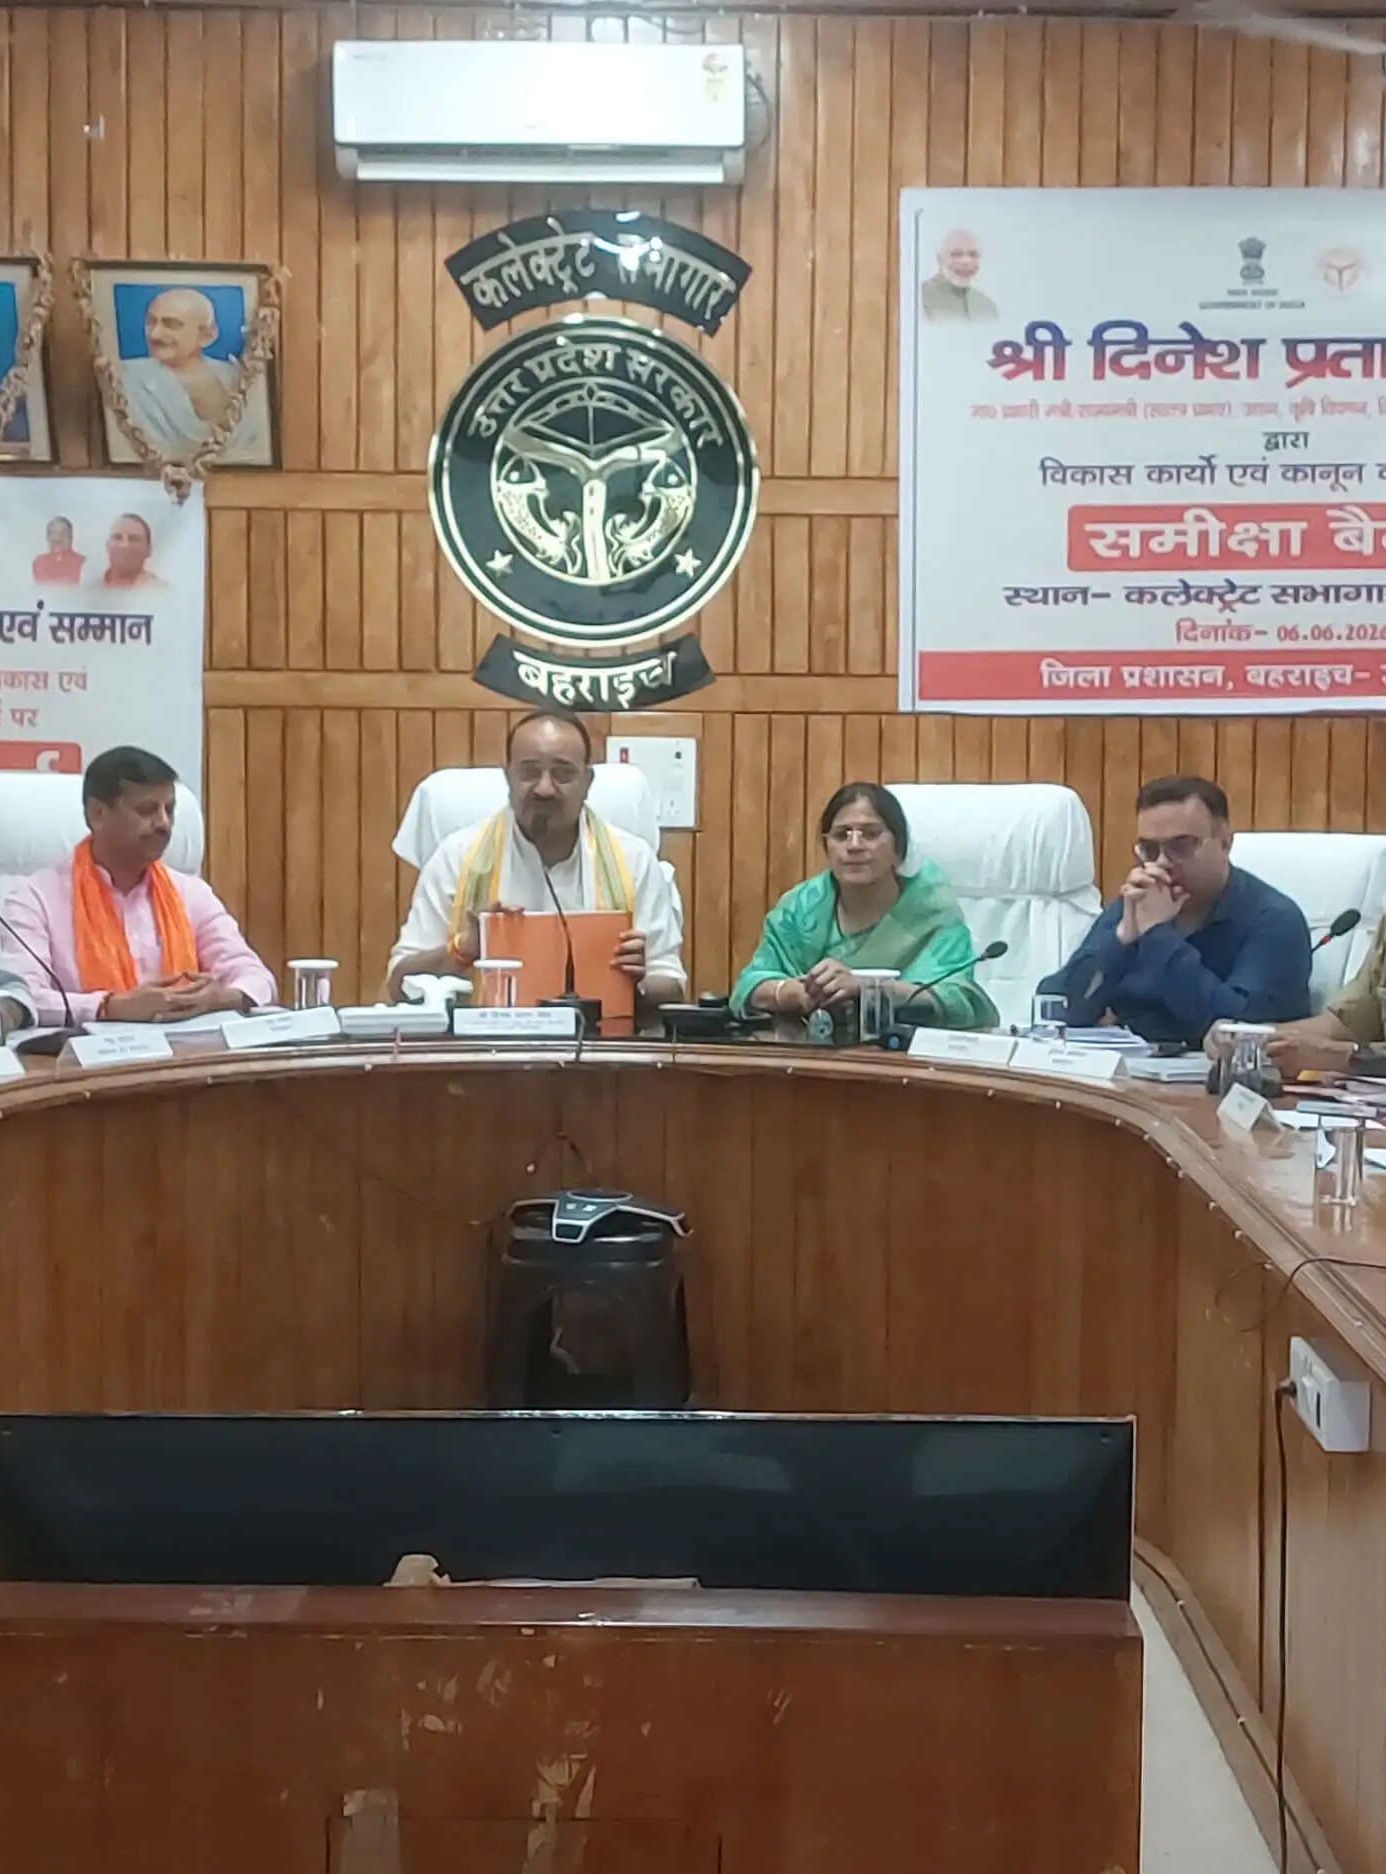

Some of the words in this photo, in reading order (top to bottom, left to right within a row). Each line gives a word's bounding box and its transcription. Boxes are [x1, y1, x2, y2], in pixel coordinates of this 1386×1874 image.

[986, 320, 1072, 381] श्री
[1087, 319, 1266, 381] दिनेश
[467, 367, 531, 438] उत्तर
[626, 348, 724, 449] सरकार
[1262, 431, 1310, 452] द्वारा
[1040, 456, 1134, 487] विकास
[1224, 456, 1270, 487] एवं
[1279, 462, 1365, 492] कानून
[1083, 507, 1308, 558] समीक्षा
[1123, 578, 1262, 613] कलेक्ट्रेट
[49, 611, 154, 645] सम्मान
[58, 665, 88, 692] एवं
[513, 650, 678, 710] बहराइच
[1040, 657, 1111, 688] जिला
[1121, 665, 1234, 691] प्रशासन,
[10, 707, 40, 727] पर
